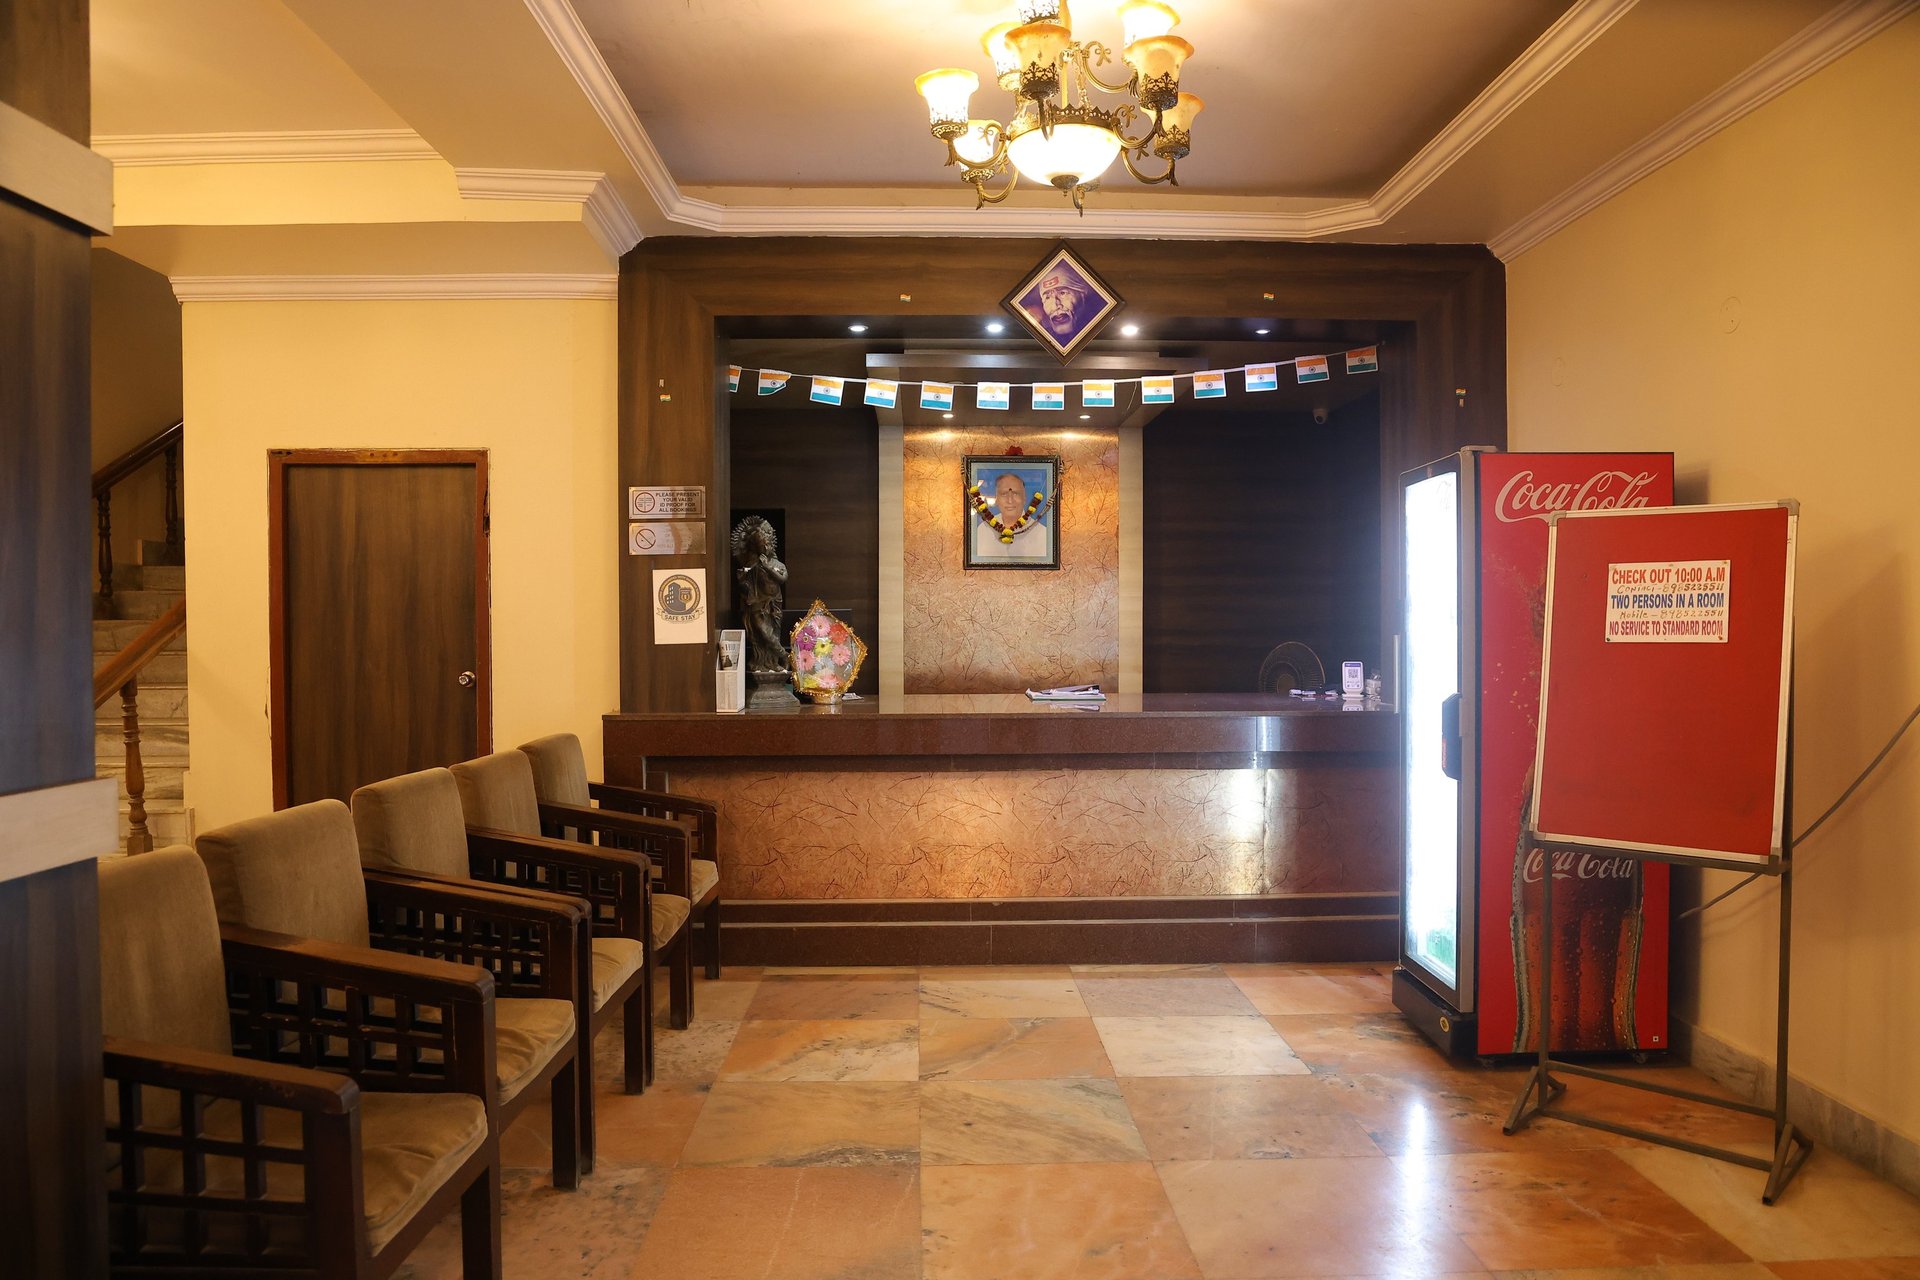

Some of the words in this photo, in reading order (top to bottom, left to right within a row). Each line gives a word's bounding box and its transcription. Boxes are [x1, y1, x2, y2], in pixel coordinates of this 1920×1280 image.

[1494, 470, 1658, 523] Coca-Cola
[1612, 568, 1647, 584] CHECK
[1649, 568, 1672, 583] OUT
[1675, 567, 1702, 583] 10:00
[1705, 567, 1726, 582] A.M
[1611, 594, 1630, 609] TWO
[1632, 593, 1673, 609] PERSONS
[1675, 593, 1686, 608] IN
[1688, 593, 1694, 608] A
[1697, 592, 1724, 608] ROOM
[1609, 621, 1619, 636] NO
[1620, 621, 1650, 636] SERVICE
[1651, 621, 1661, 635] TO
[1662, 620, 1700, 635] STANDARD
[1701, 620, 1723, 635] ROOM
